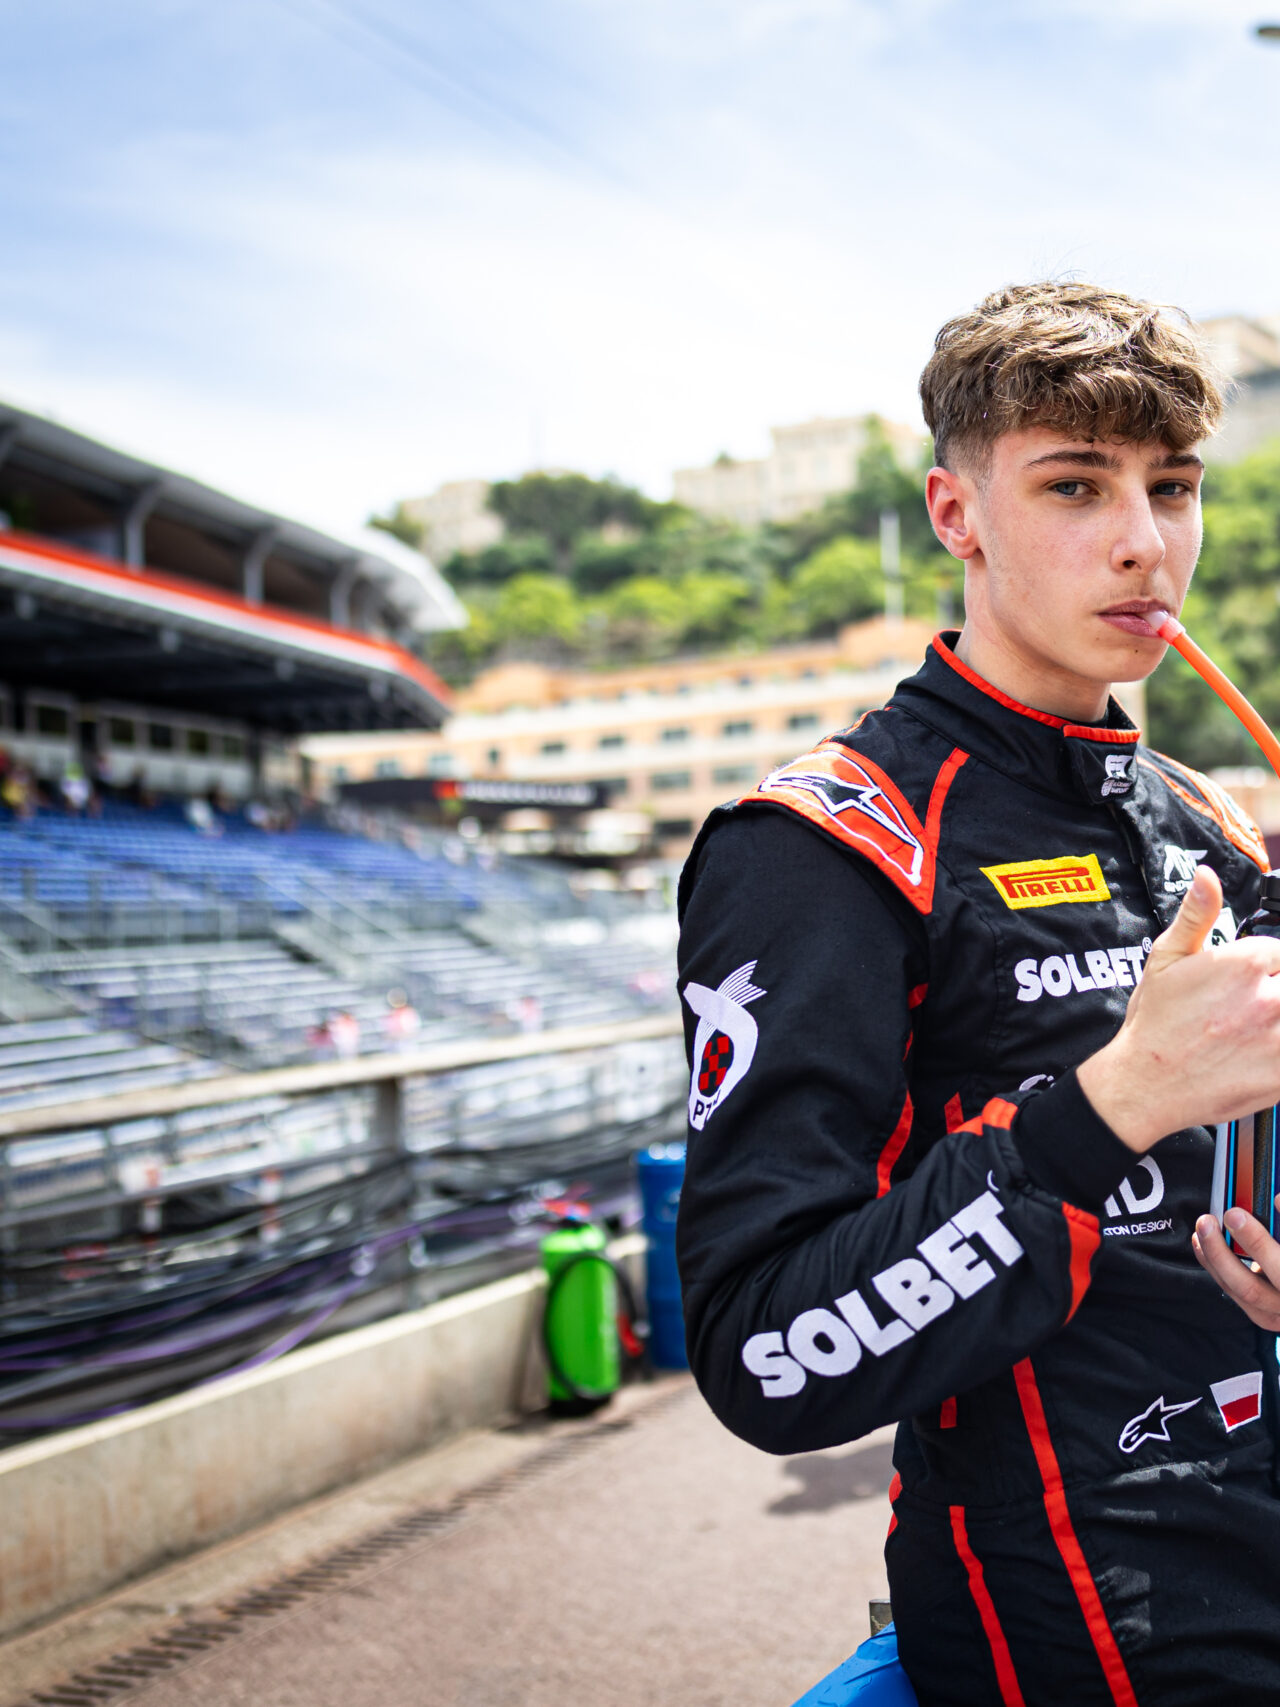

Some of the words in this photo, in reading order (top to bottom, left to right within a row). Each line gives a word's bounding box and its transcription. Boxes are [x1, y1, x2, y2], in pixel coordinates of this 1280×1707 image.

[996, 867, 1096, 899] PIRELLI
[1014, 946, 1144, 1002] SOLBET
[1131, 1219, 1172, 1235] DESIGN
[742, 1190, 1024, 1398] SOLBET
